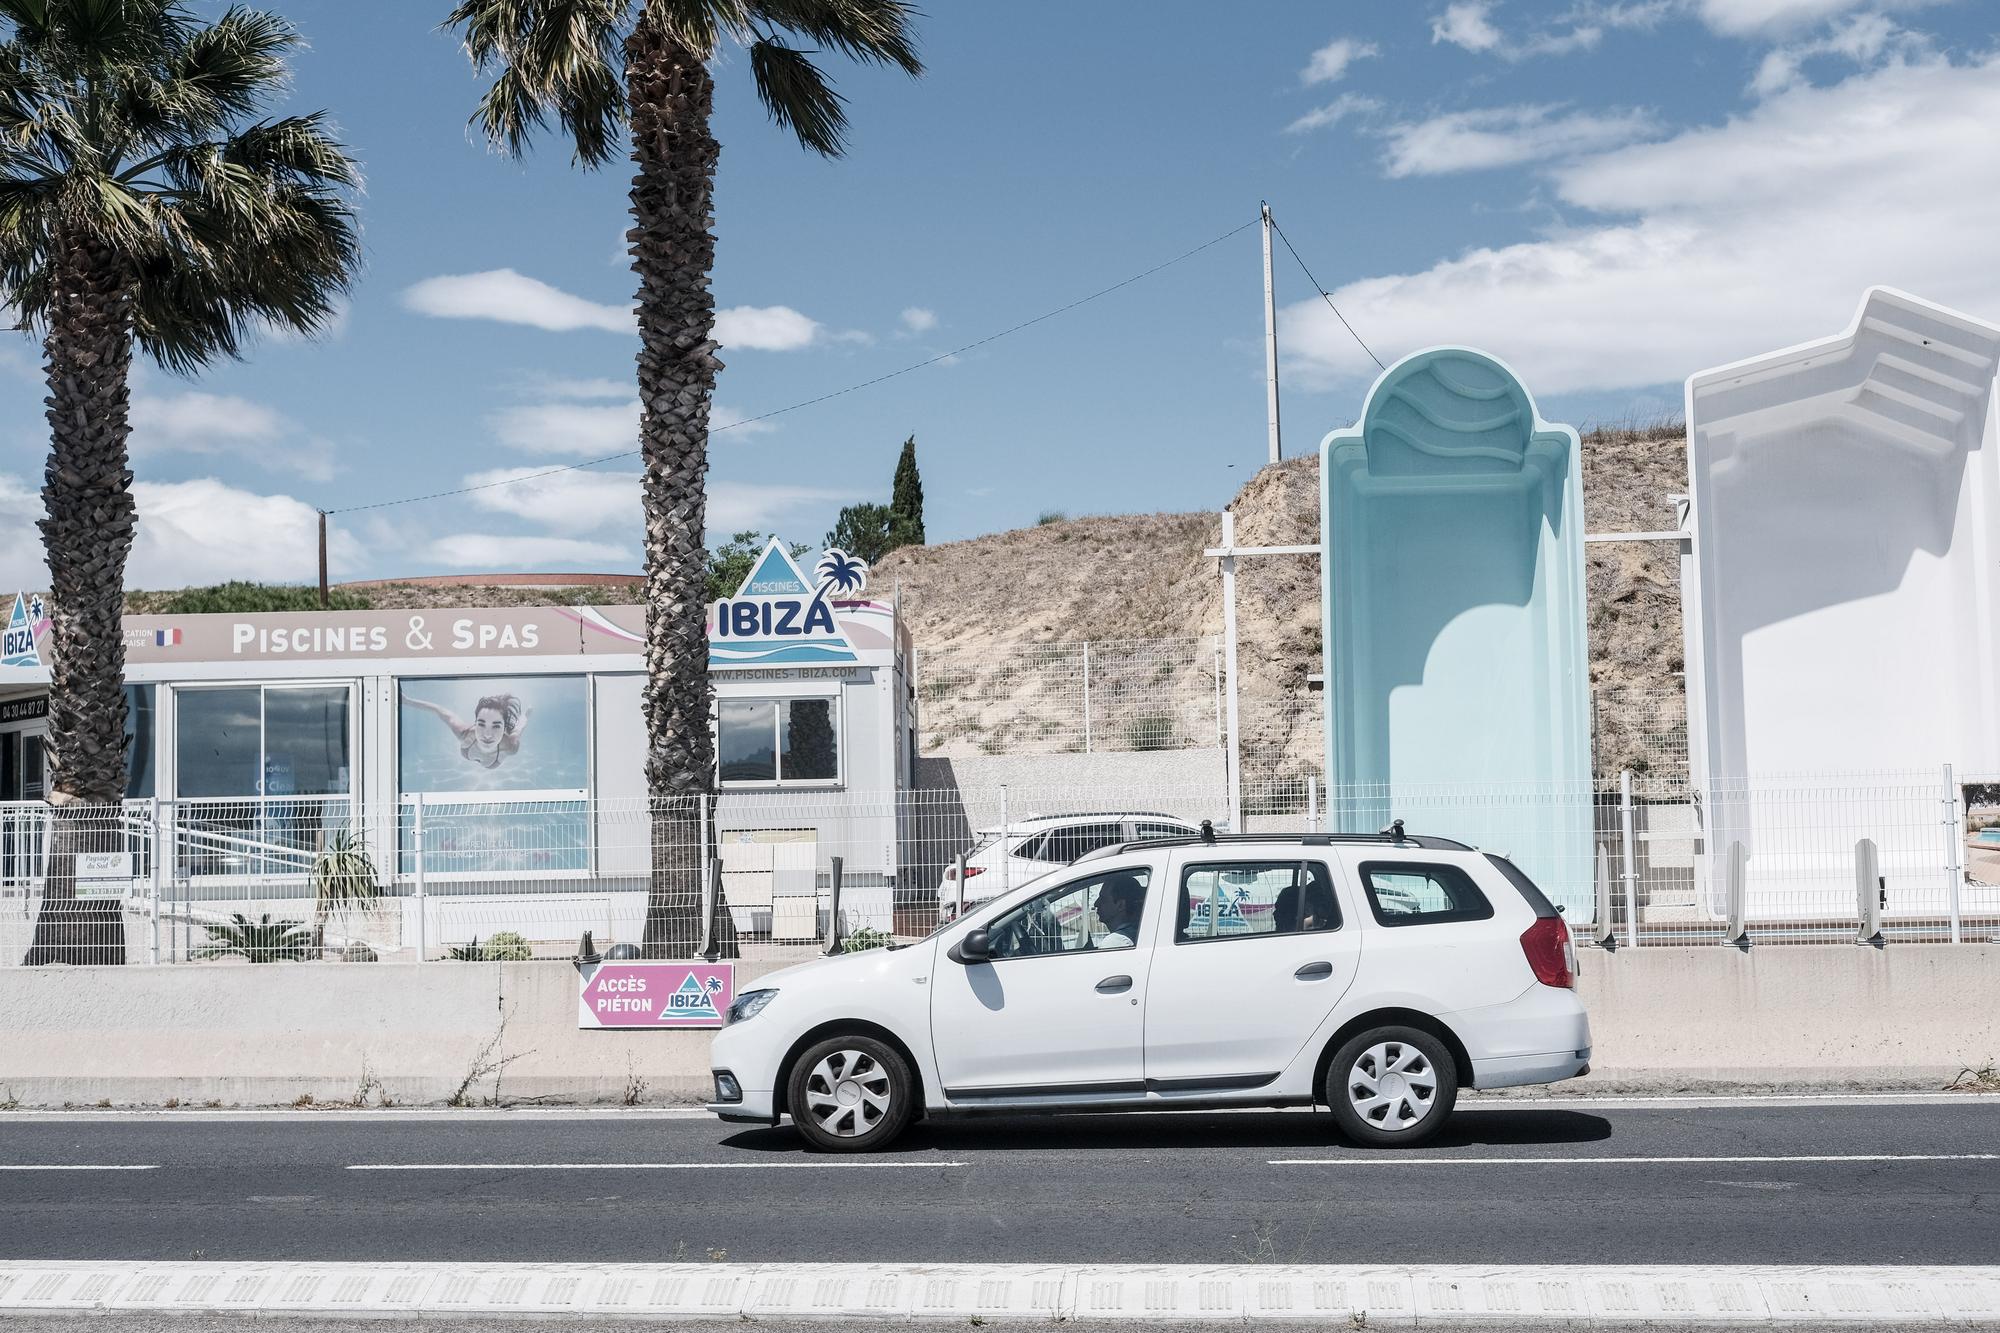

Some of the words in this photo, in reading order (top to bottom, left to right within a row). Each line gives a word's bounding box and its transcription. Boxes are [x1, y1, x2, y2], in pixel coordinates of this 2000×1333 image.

[751, 580, 800, 593] PISCINES
[719, 600, 836, 637] IBIZA
[124, 629, 153, 637] CATION
[233, 623, 388, 653] PISCINES
[405, 615, 434, 650] &
[452, 619, 539, 649] SPAS
[4, 631, 34, 656] IBIZA
[711, 669, 794, 680] WW.PISCINES-
[798, 667, 857, 678] IBIZA.COM
[11, 704, 19, 718] 30
[19, 702, 27, 716] 44
[28, 701, 35, 715] 87
[36, 700, 45, 713] 27
[1198, 904, 1239, 917] IBZA
[597, 975, 647, 992] ACCÈS
[597, 994, 652, 1012] PIÉTON
[670, 994, 711, 1008] IBIZA
